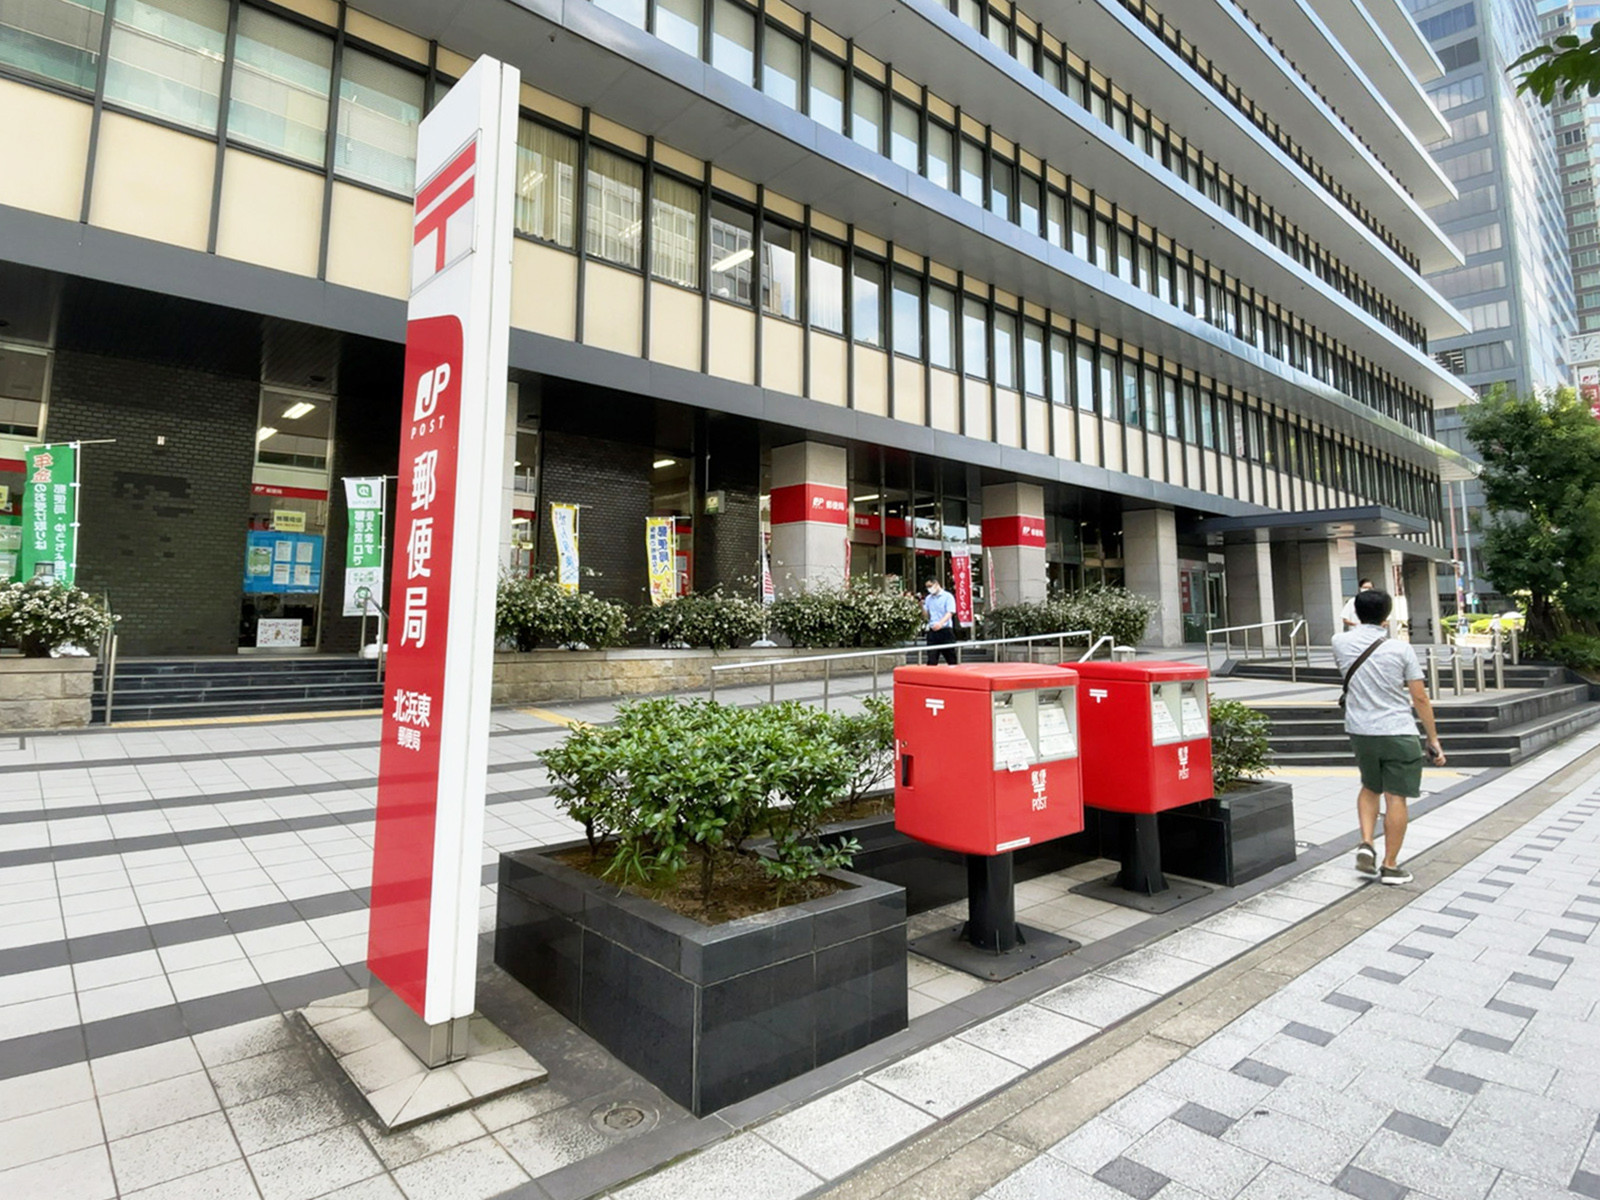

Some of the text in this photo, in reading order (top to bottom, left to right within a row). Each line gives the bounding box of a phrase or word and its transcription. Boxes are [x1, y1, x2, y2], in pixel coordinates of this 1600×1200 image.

[411, 415, 446, 439] POST
[400, 450, 438, 648] 郵便局
[392, 688, 432, 727] 北浜東
[397, 726, 421, 751] 郵便局
[1032, 796, 1048, 812] POST
